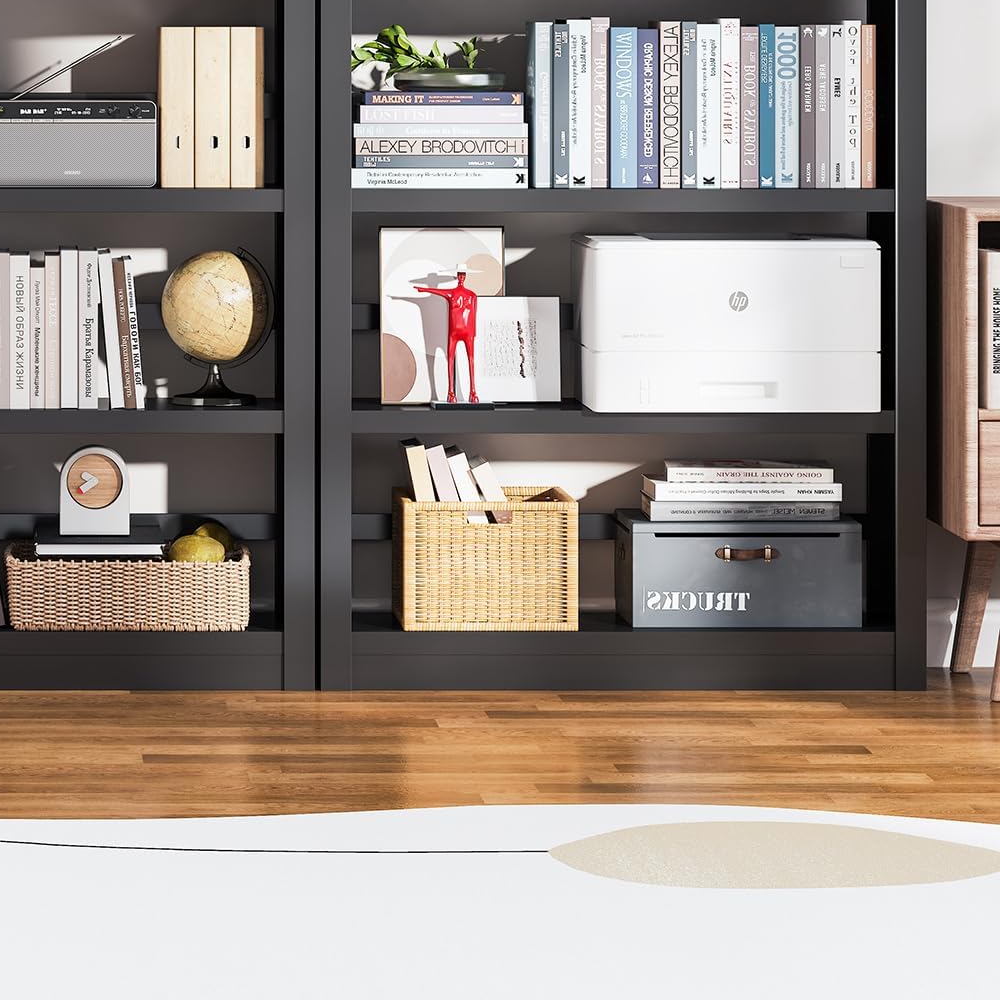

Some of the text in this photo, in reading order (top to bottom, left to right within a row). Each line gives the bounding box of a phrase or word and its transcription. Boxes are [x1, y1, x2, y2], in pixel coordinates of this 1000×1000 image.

[372, 95, 412, 104] MAKING
[414, 95, 425, 104] IT
[359, 140, 517, 153] ALEXEY BRODOVITCH
[729, 291, 749, 312] hp
[15, 275, 25, 390] НОВЫЙ ОБРАЗ ЖИЗНИ
[129, 311, 143, 387] ГОВОРИ КАК БОГ
[83, 317, 94, 398] Братья Карамазовы
